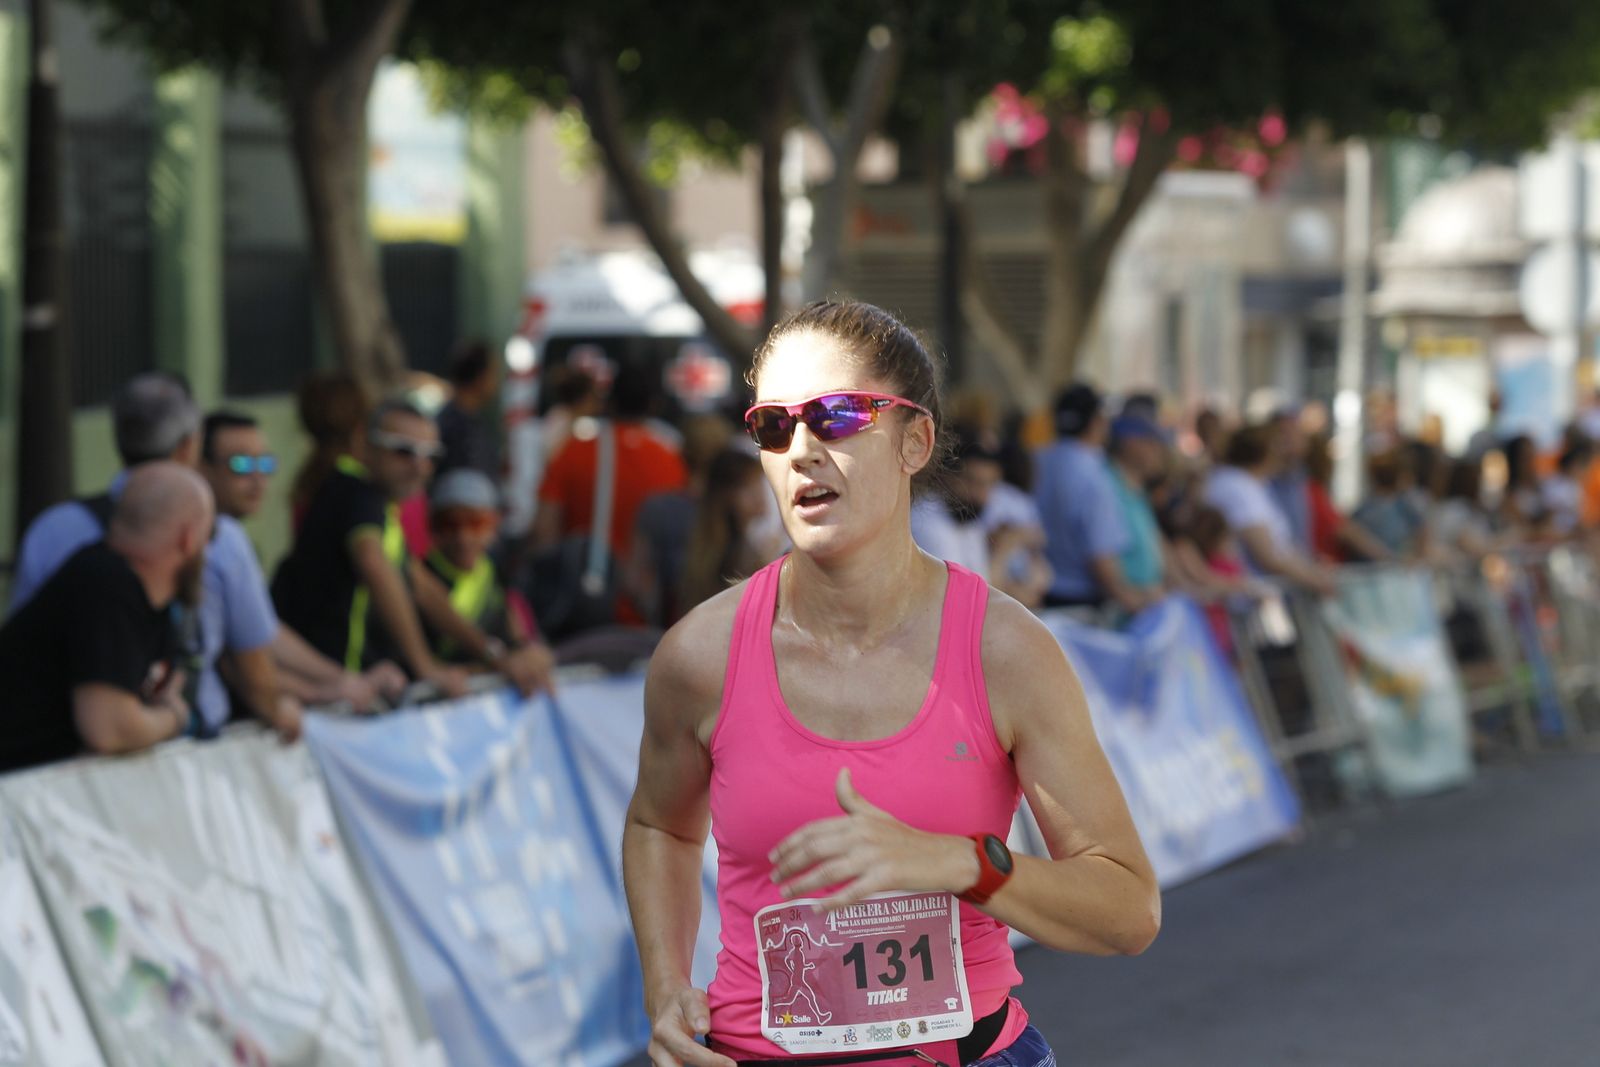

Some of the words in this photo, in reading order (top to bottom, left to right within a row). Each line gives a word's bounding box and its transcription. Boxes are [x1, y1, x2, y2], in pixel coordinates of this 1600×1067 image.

[836, 902, 890, 920] CARRERA
[891, 896, 947, 914] SOLIDARIA
[837, 919, 849, 928] POR
[850, 918, 861, 927] LAS
[861, 914, 902, 926] ENFERMEDADES
[902, 912, 916, 921] POCO
[916, 909, 948, 919] FRECUENTES
[843, 934, 934, 989] 131
[867, 988, 908, 1005] TITACE
[775, 1016, 784, 1024] La
[793, 1015, 811, 1024] Salle
